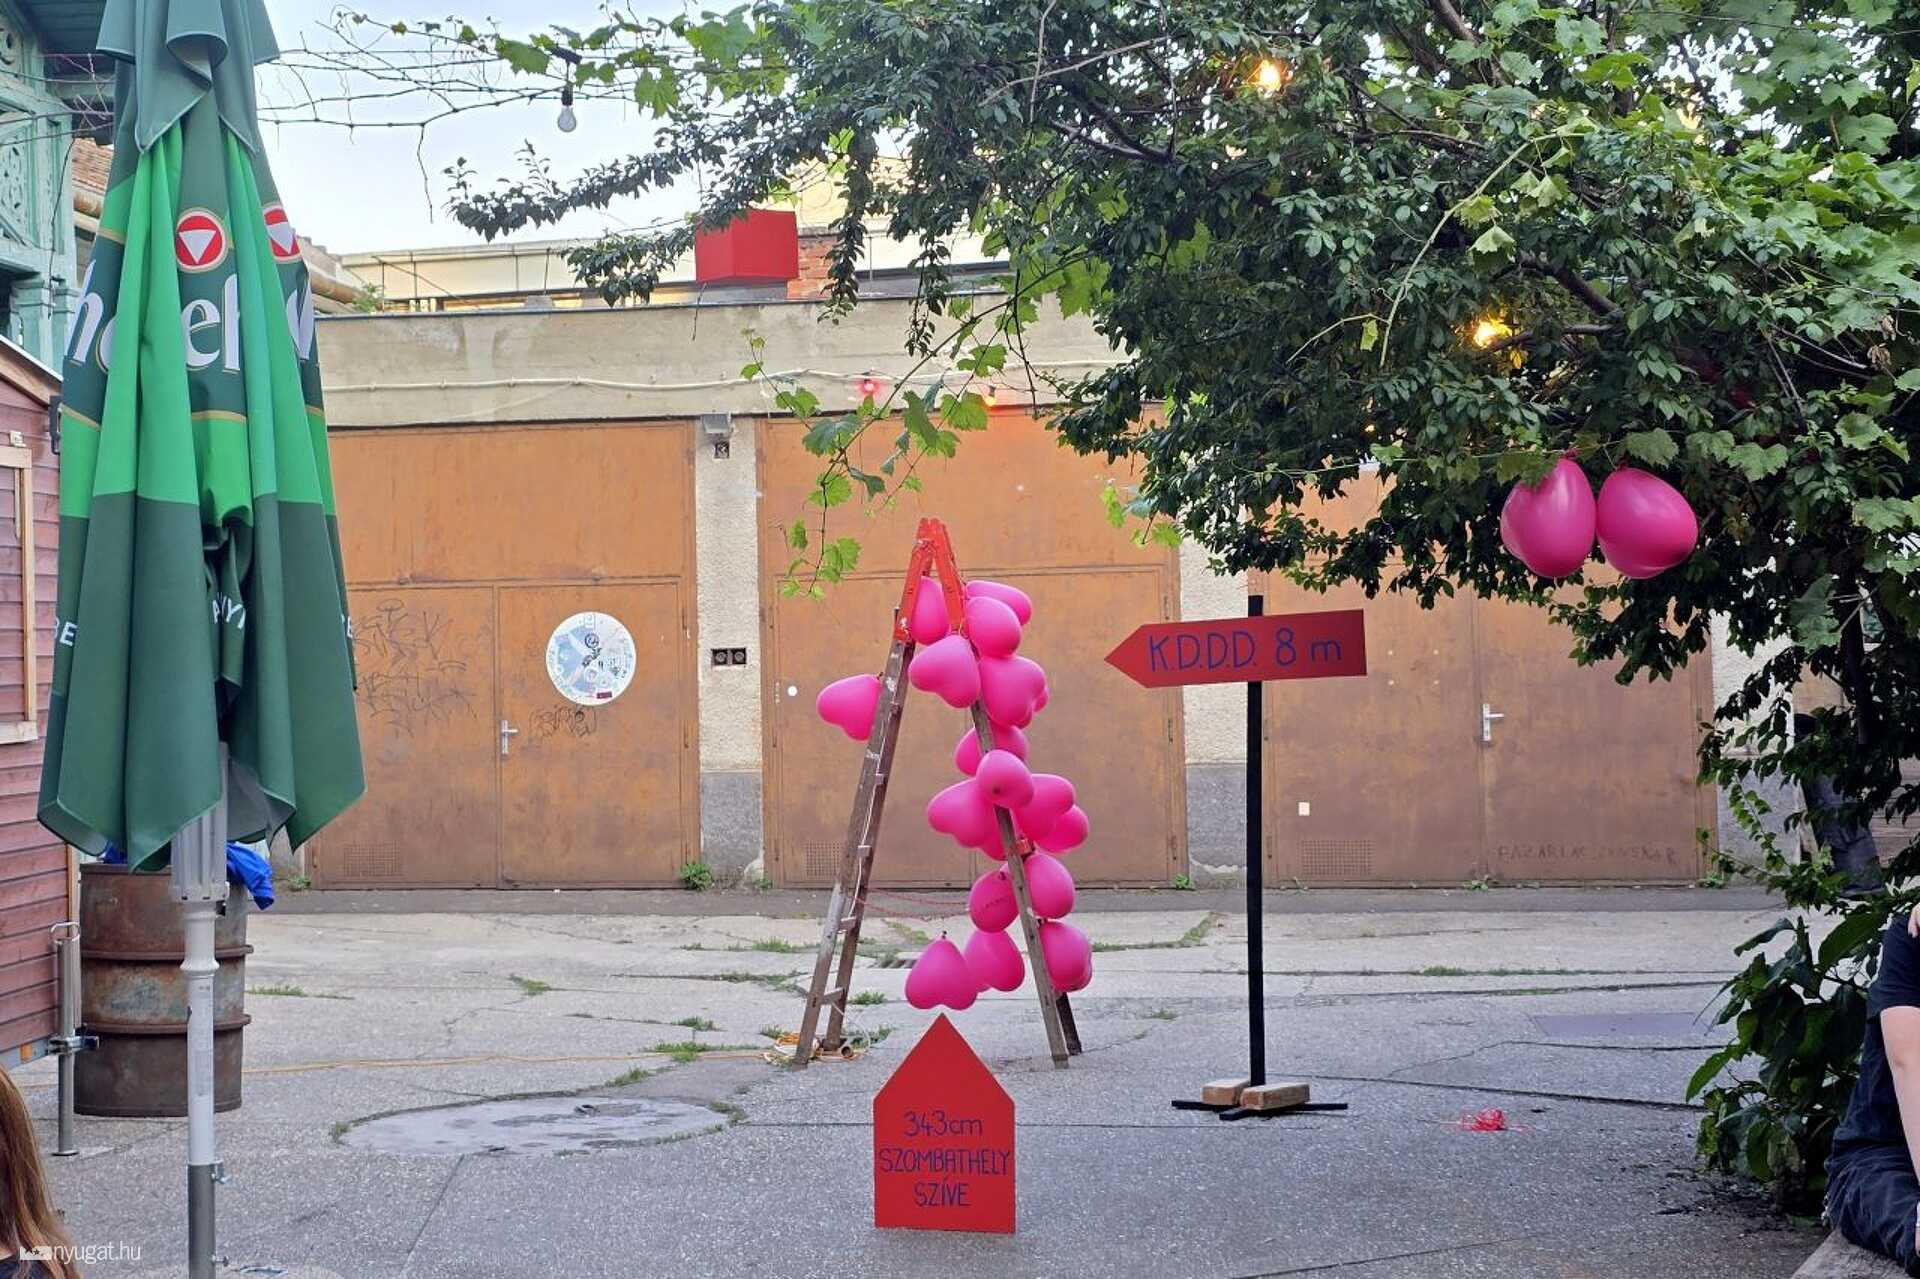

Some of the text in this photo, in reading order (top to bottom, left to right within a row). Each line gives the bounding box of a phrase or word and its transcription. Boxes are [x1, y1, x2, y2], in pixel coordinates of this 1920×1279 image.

[1275, 627, 1297, 667] 8
[1309, 639, 1342, 663] m
[879, 1147, 1010, 1176] SZOMBATHELY
[914, 1174, 972, 1208] SZÍVE
